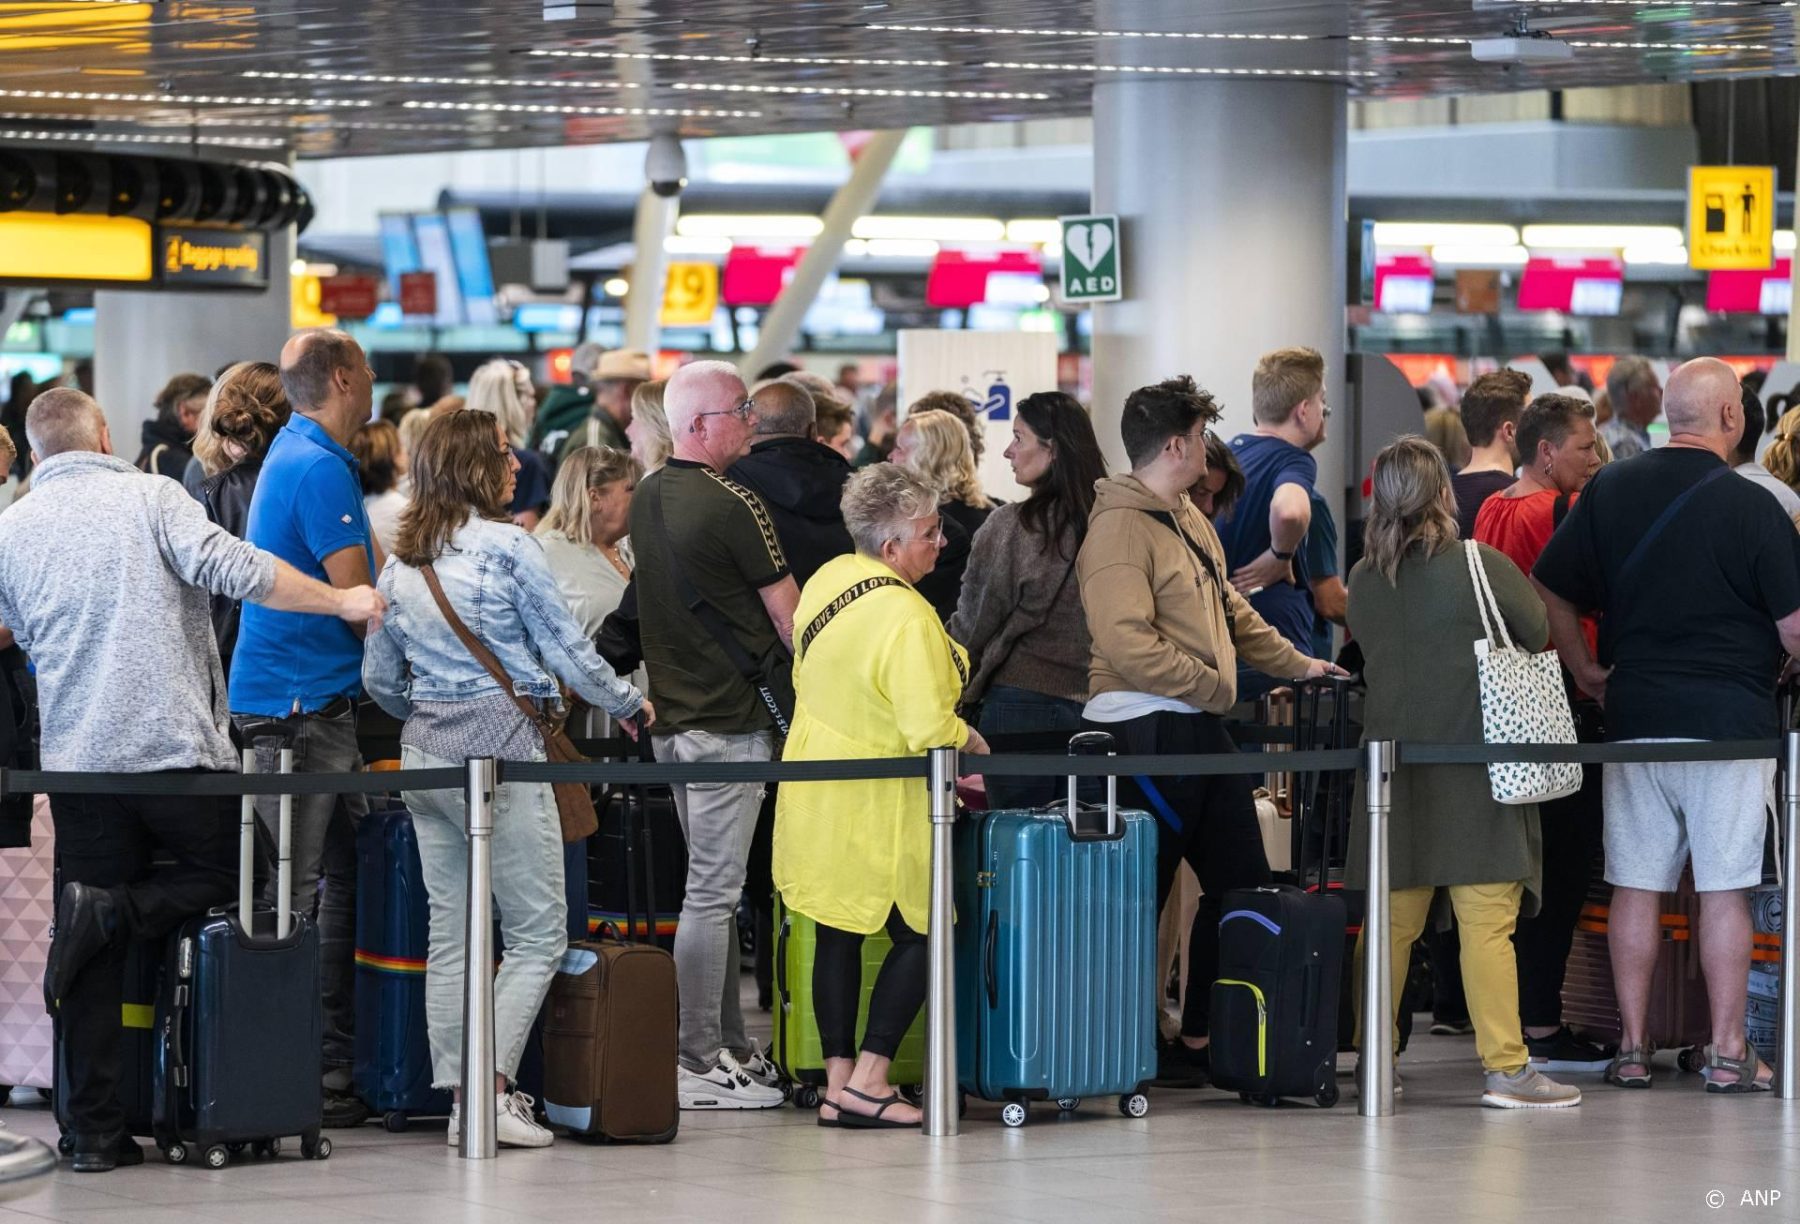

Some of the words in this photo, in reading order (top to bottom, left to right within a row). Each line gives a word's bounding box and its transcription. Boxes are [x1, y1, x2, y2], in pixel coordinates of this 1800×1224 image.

[1069, 276, 1114, 294] AED
[759, 686, 780, 713] SCOTT
[776, 718, 790, 737] YLE
